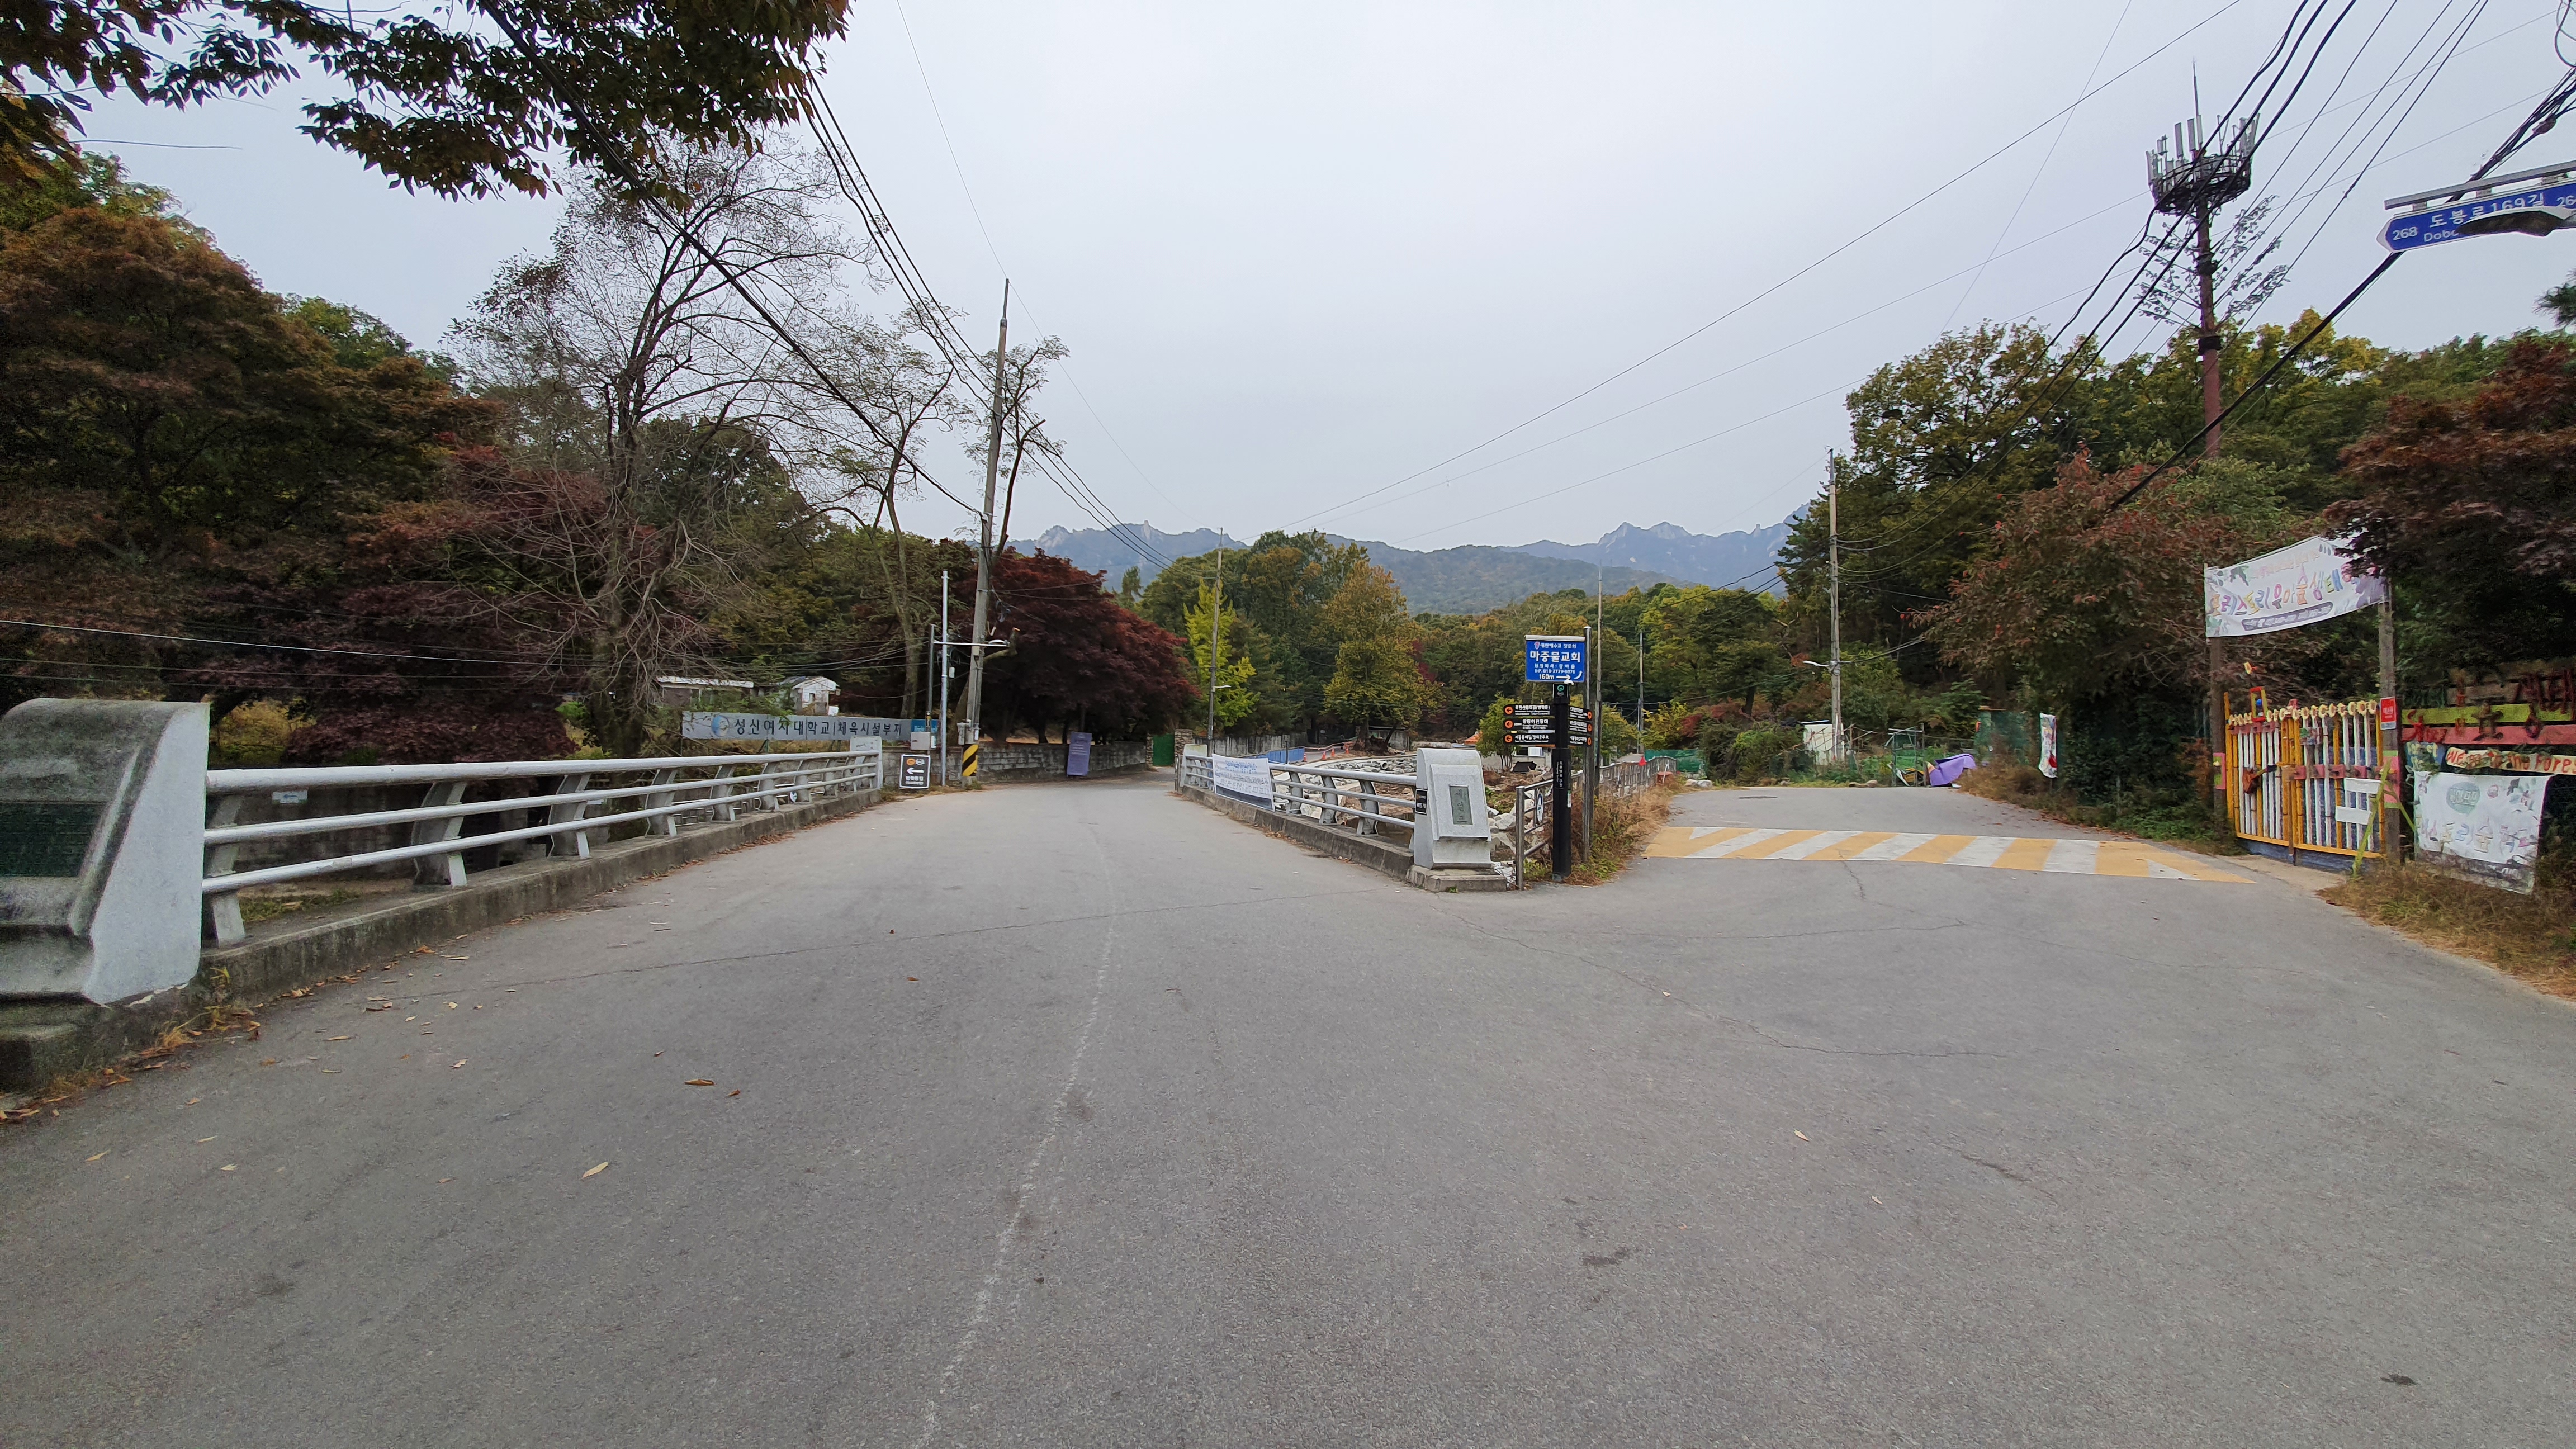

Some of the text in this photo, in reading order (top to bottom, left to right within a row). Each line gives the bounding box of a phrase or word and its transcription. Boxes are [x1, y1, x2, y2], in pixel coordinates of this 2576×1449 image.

[2556, 195, 2576, 207] 26
[2392, 226, 2418, 241] 268
[2423, 230, 2460, 243] Dobo
[1530, 651, 1580, 663] 마중물교회
